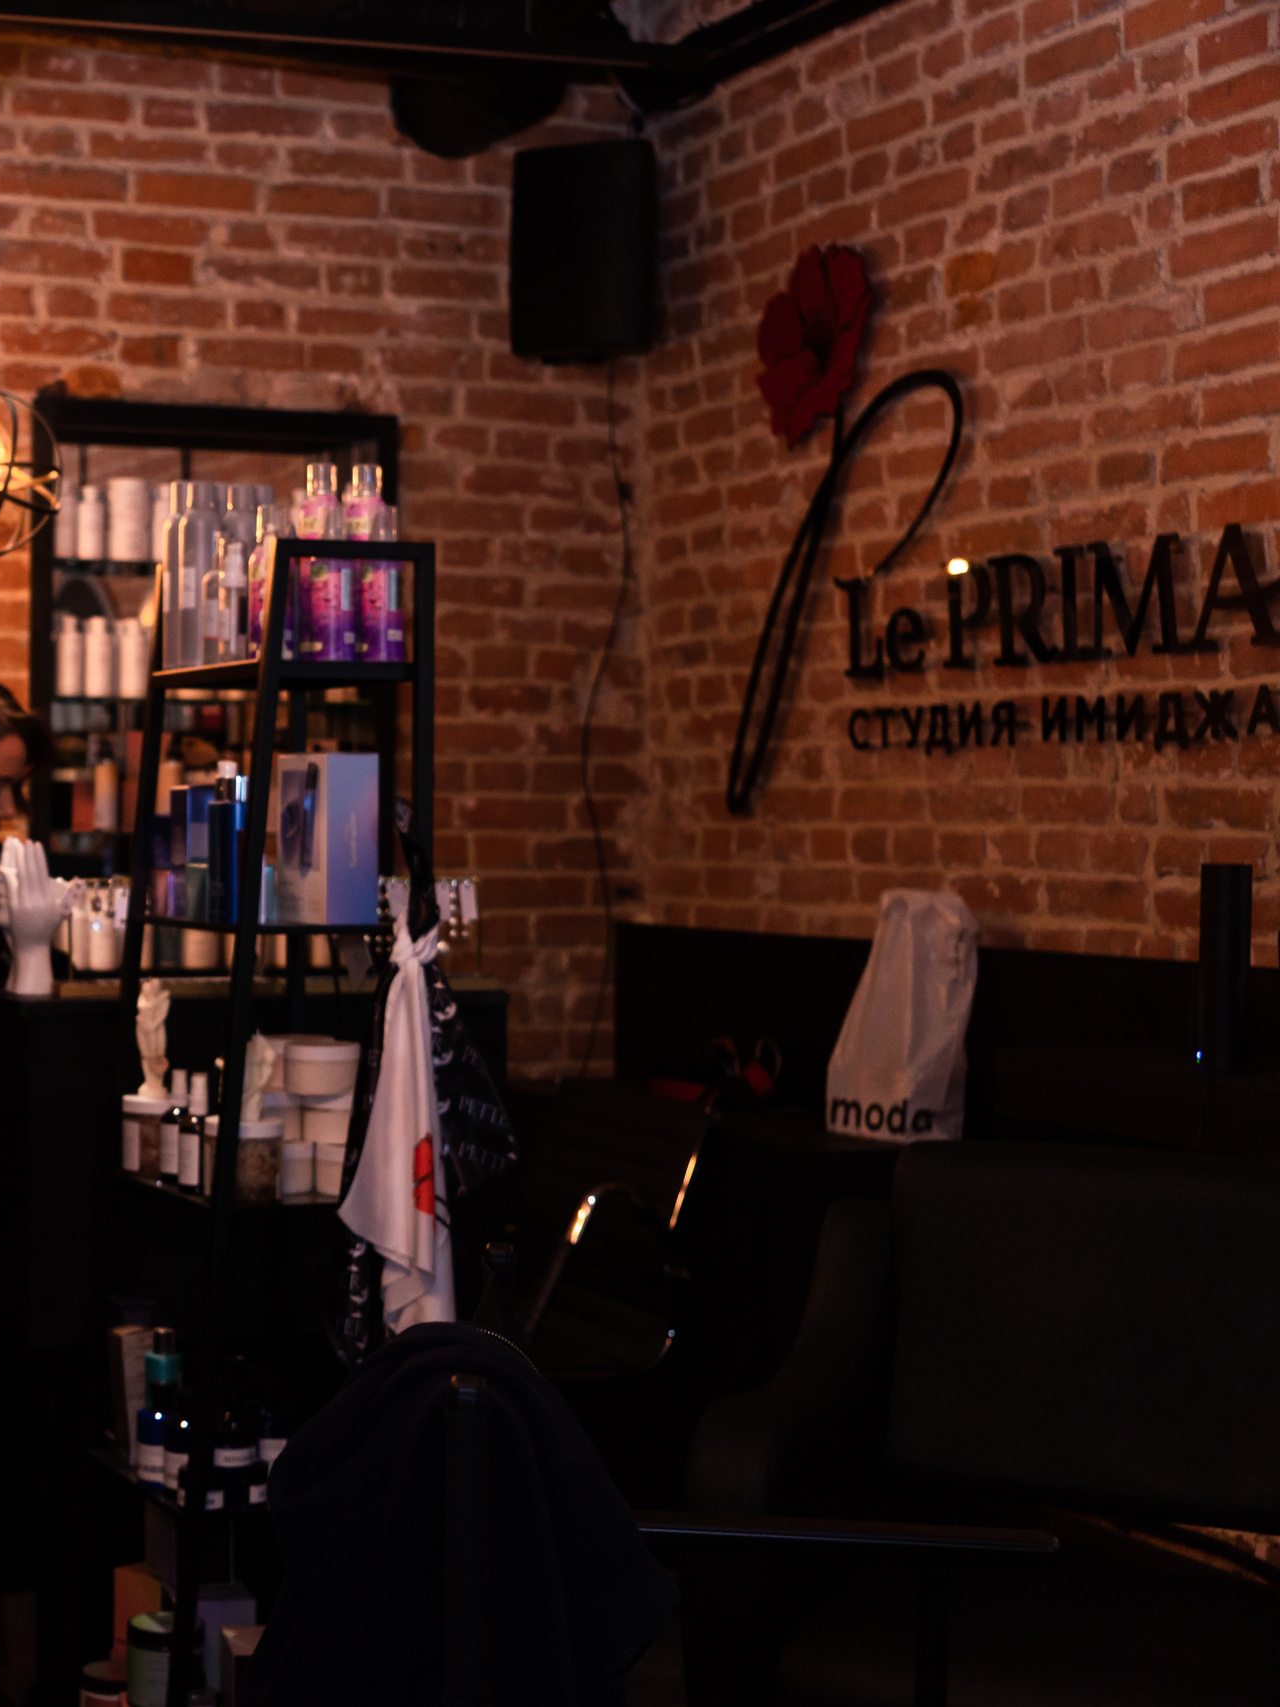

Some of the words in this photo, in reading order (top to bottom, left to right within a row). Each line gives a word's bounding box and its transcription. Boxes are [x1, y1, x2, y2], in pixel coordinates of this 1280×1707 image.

[944, 523, 1280, 669] PRIMA
[849, 702, 1017, 754] СТУДИЯ
[1040, 684, 1280, 750] ИМИДЖА
[830, 1098, 934, 1133] moda
